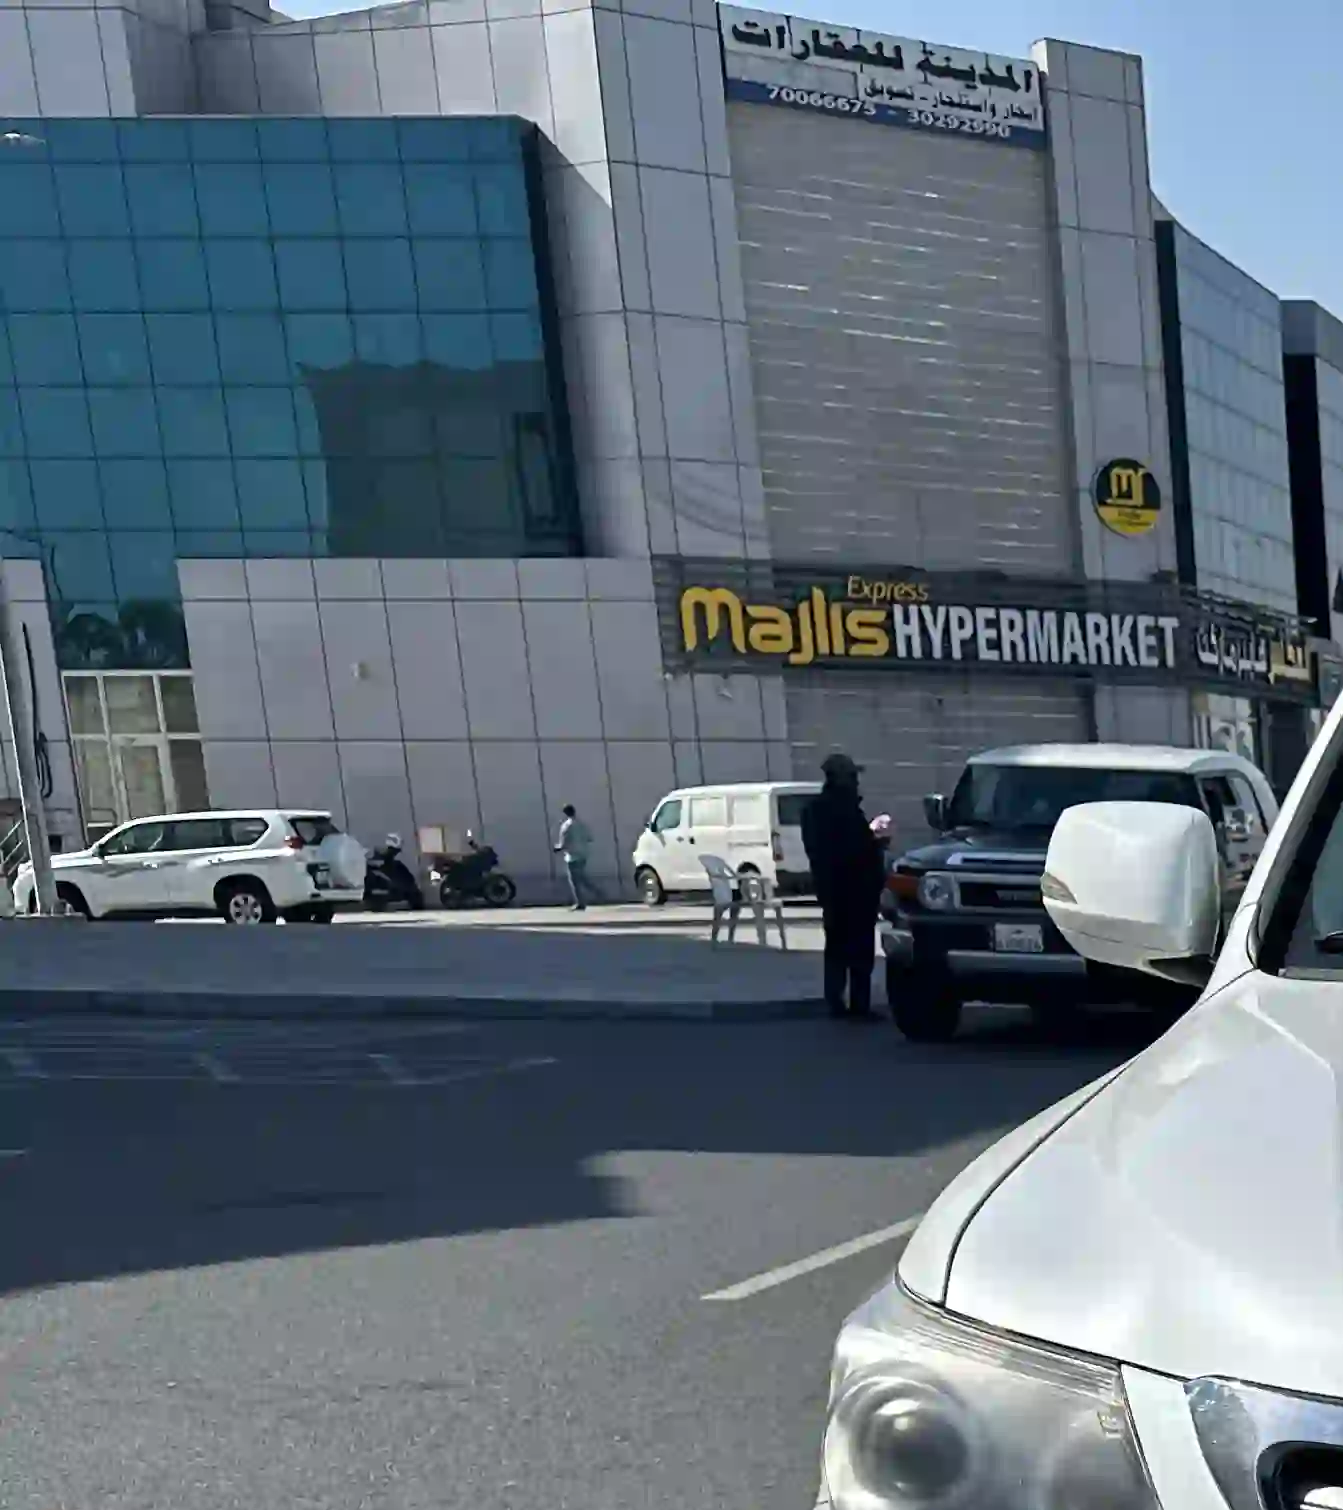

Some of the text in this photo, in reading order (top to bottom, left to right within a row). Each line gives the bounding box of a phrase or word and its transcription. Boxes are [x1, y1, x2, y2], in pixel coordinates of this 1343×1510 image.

[731, 21, 1034, 93] المدينة للعقارات
[848, 574, 928, 606] Express
[680, 586, 1180, 668] Majlis HYPERMARKET
